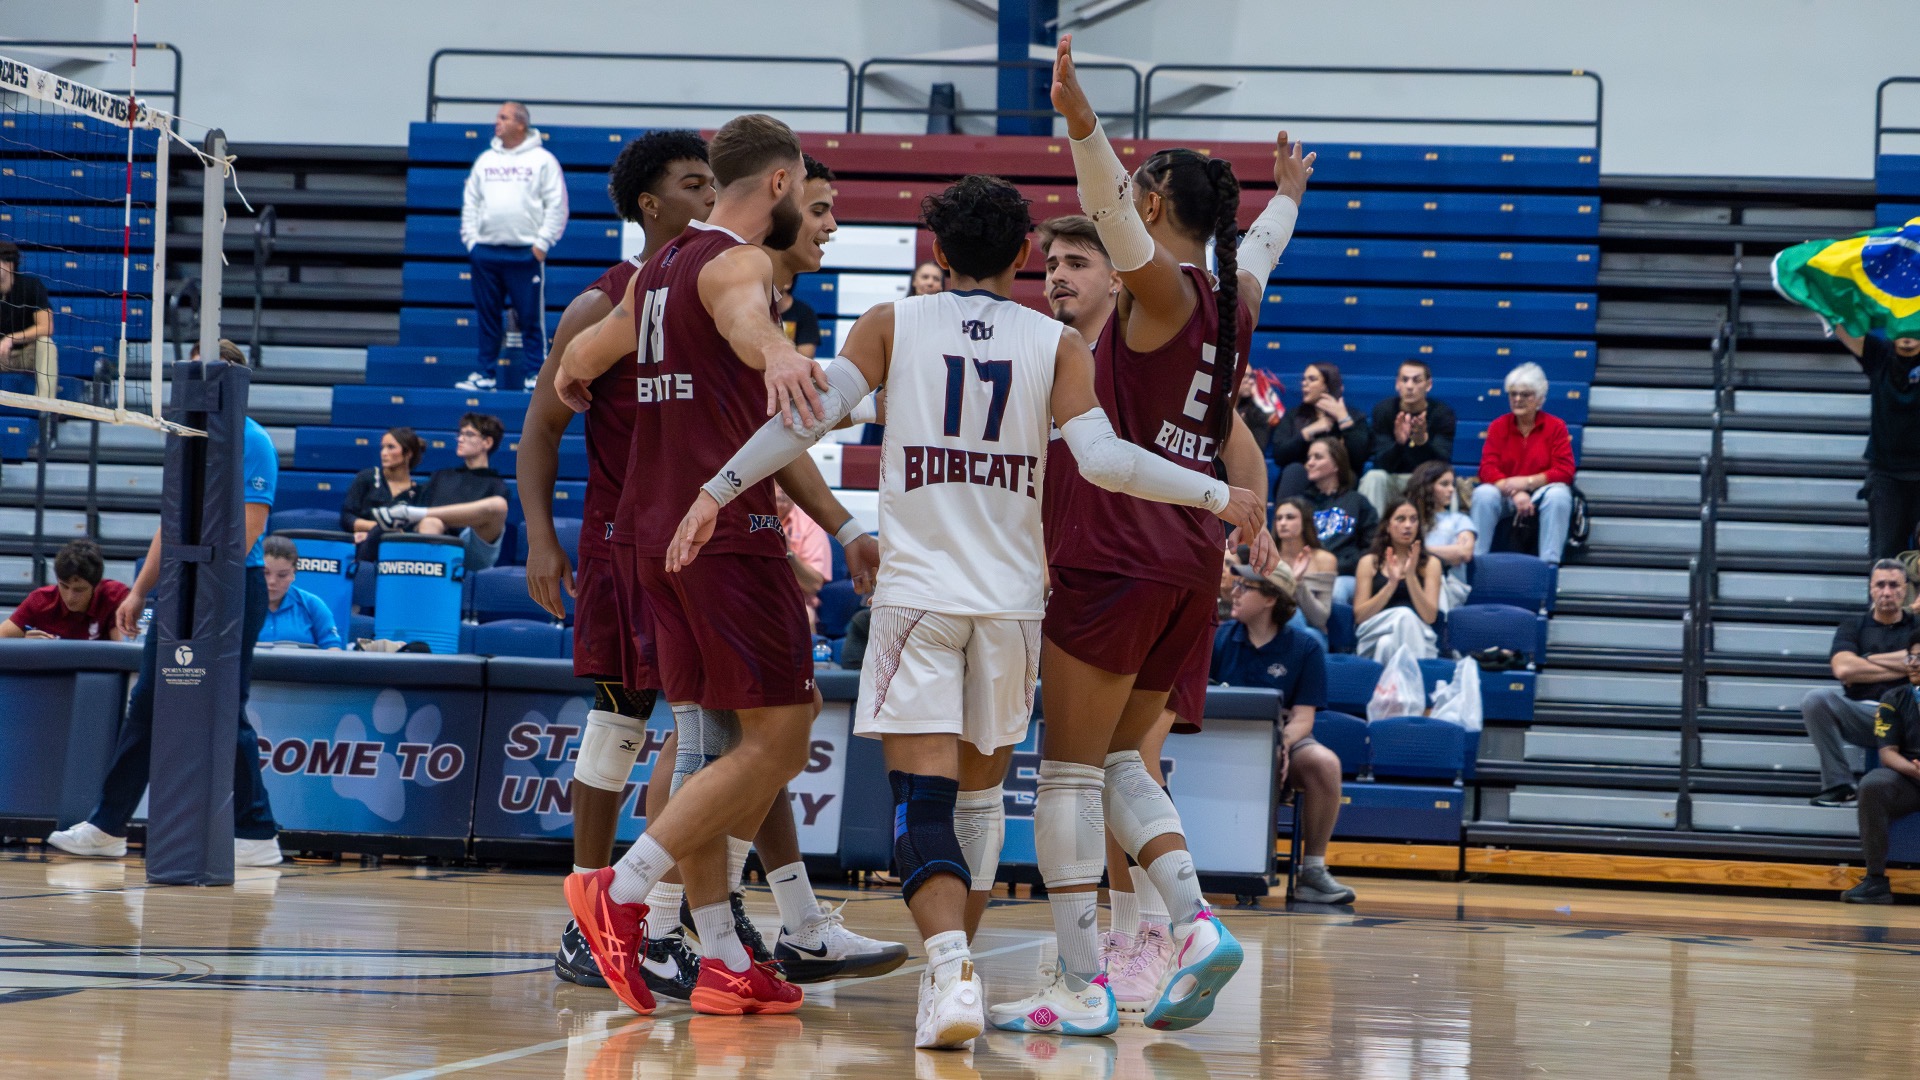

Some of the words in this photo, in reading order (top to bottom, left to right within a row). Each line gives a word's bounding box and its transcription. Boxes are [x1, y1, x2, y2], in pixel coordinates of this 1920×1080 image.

[942, 354, 1012, 442] 17
[1154, 419, 1224, 462] BOBC
[297, 557, 339, 574] ERADE
[396, 742, 465, 782] TO
